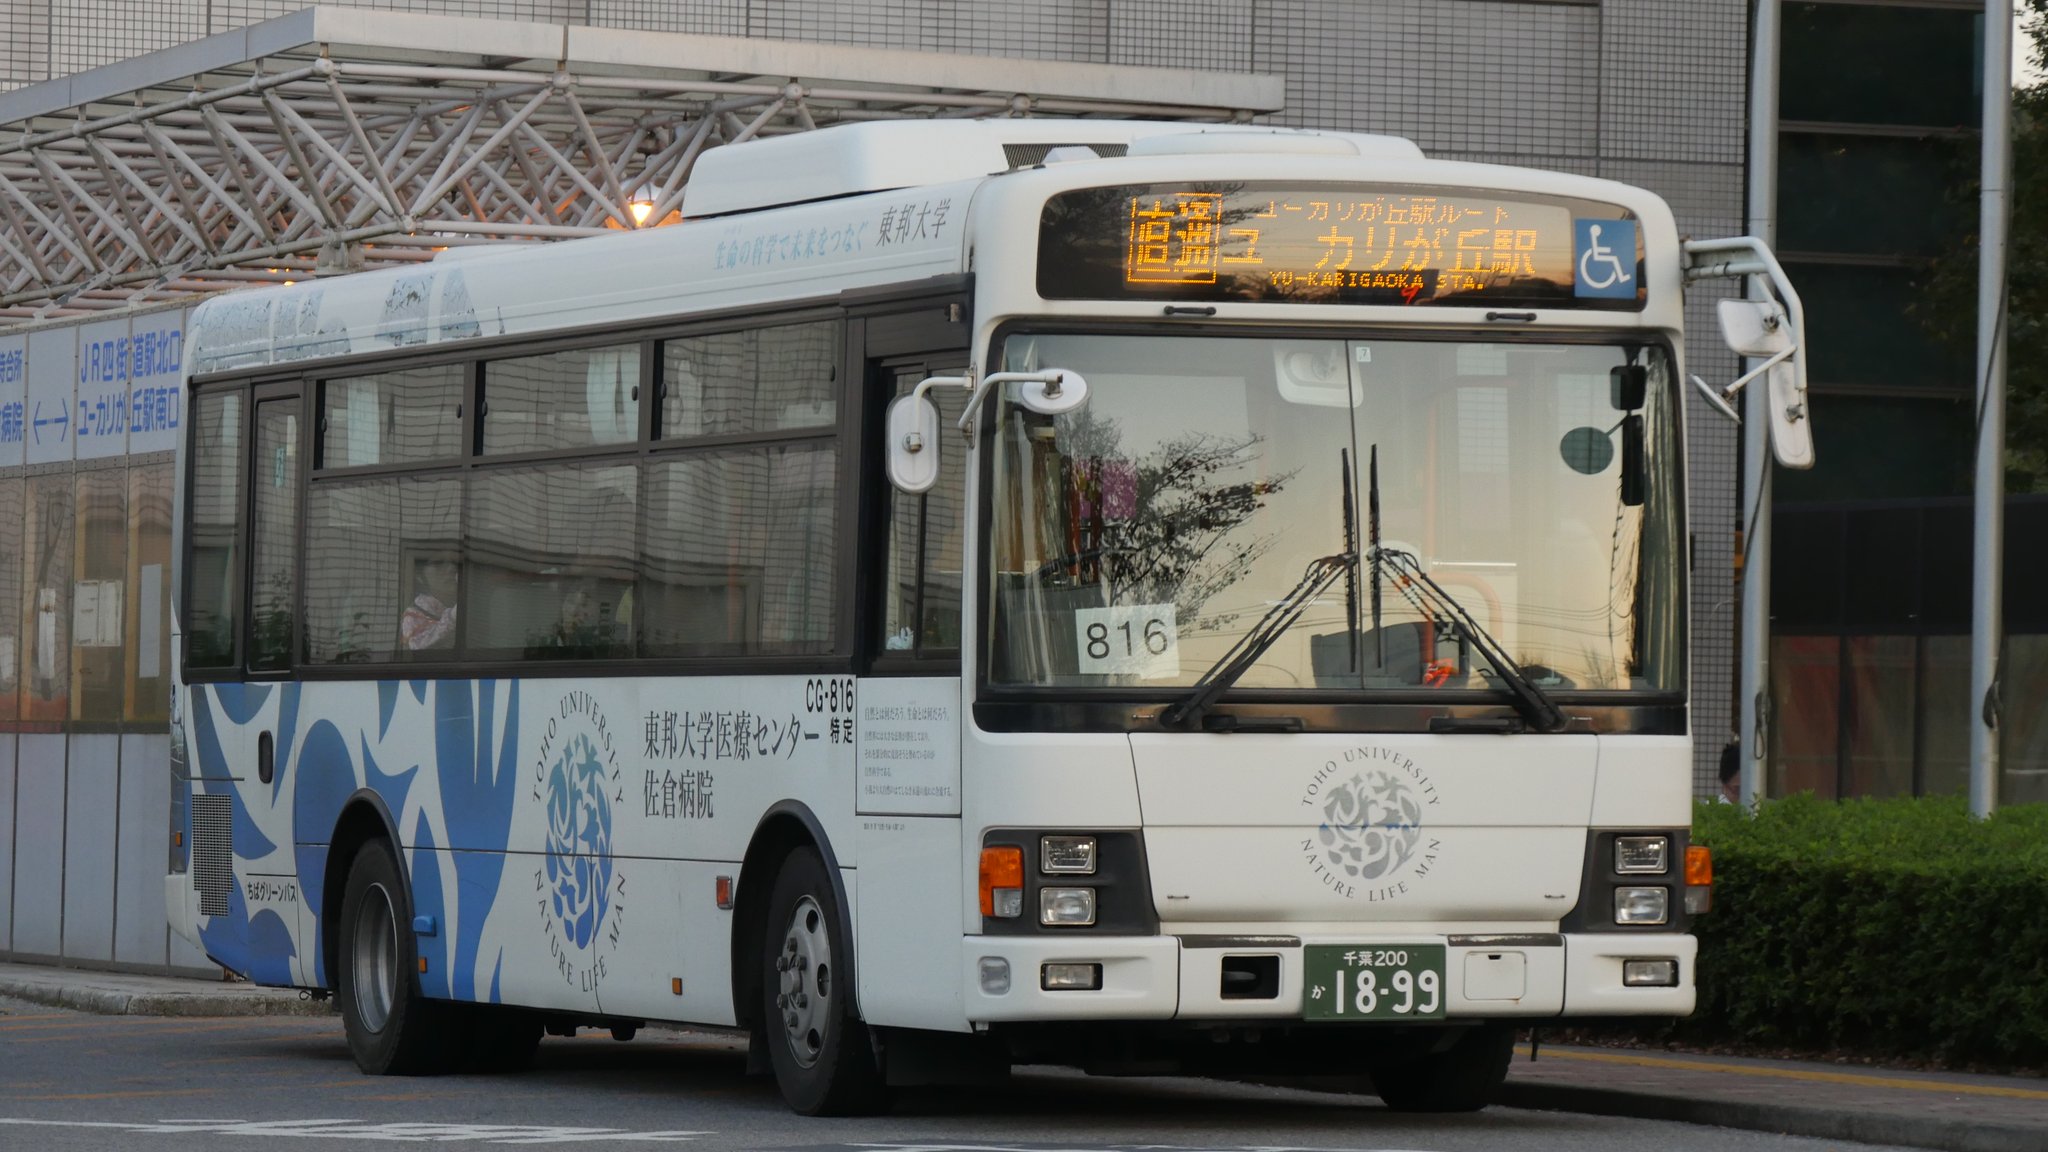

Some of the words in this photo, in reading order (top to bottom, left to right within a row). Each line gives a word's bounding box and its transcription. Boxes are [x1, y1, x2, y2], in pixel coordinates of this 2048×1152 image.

[713, 221, 869, 271] 生命の科学で未来をつなぐ
[876, 198, 952, 247] 東邦大学
[1222, 226, 1538, 275] ユカリが丘駅
[1269, 270, 1425, 289] YU-KARIGAOKA
[1435, 274, 1485, 291] STA.
[0, 401, 23, 442] 病院
[78, 387, 180, 436] ユーカリが丘駅南口
[1087, 618, 1168, 660] 816
[533, 717, 556, 802] TOHO
[560, 690, 624, 804] UNIVERSITY
[643, 710, 820, 762] 東邦大学医療センター
[829, 717, 854, 744] 特定
[643, 769, 715, 819] 佐倉病院
[1301, 760, 1338, 806] TOHO
[1343, 746, 1440, 806] UNIVERSITY
[247, 882, 297, 902] ちばグリーンバス
[1301, 838, 1356, 899] NATURE
[1368, 880, 1409, 902] LIFE
[1414, 837, 1441, 878] MAN
[534, 867, 573, 986] NATURE
[581, 955, 607, 993] LIFE
[609, 871, 626, 951] MAN
[1311, 984, 1327, 1000] か
[1336, 968, 1440, 1014] 18-99
